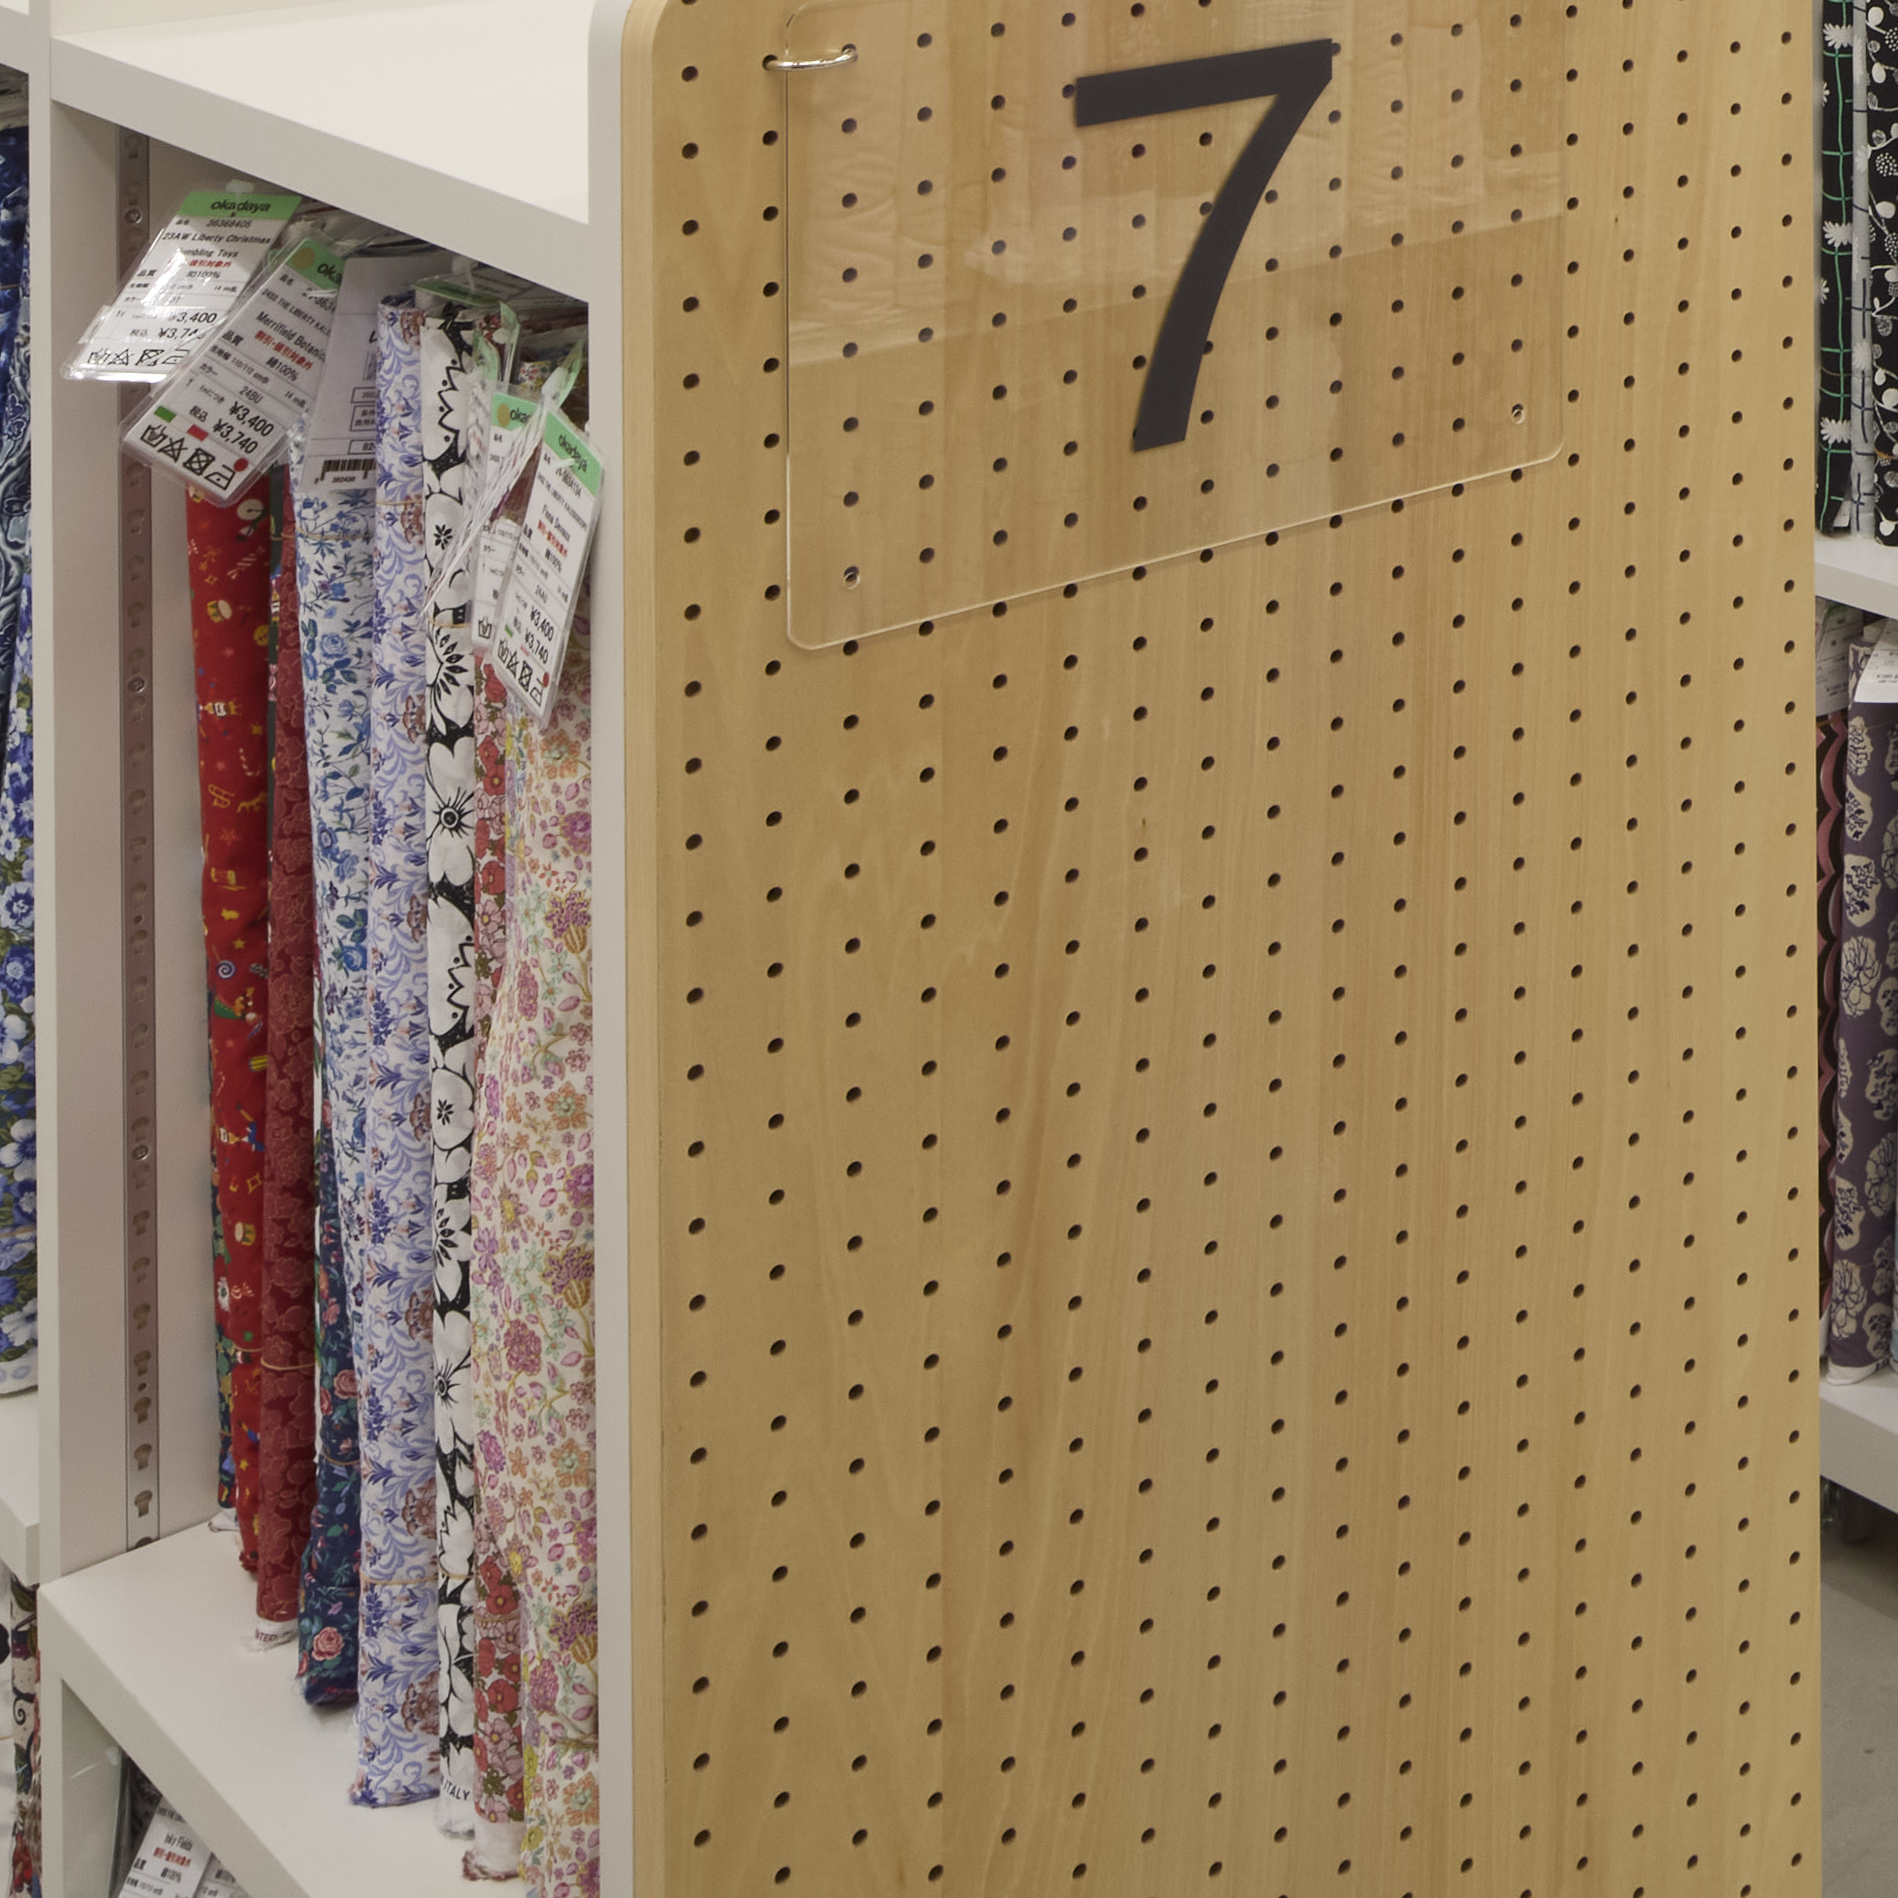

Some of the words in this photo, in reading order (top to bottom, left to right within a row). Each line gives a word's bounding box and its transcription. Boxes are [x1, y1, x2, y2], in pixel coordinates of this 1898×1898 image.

[210, 199, 272, 213] okadaya
[191, 232, 225, 244] Liberty
[226, 233, 272, 245] Christmas
[217, 248, 239, 259] Toys
[1075, 38, 1334, 452] 7
[256, 311, 296, 344] Merrifield
[212, 418, 259, 455] ¥3,740
[228, 401, 274, 438] ¥3,400
[530, 605, 555, 642] ¥3,400
[525, 627, 549, 665] ¥3,740
[444, 1781, 470, 1801] ITALY
